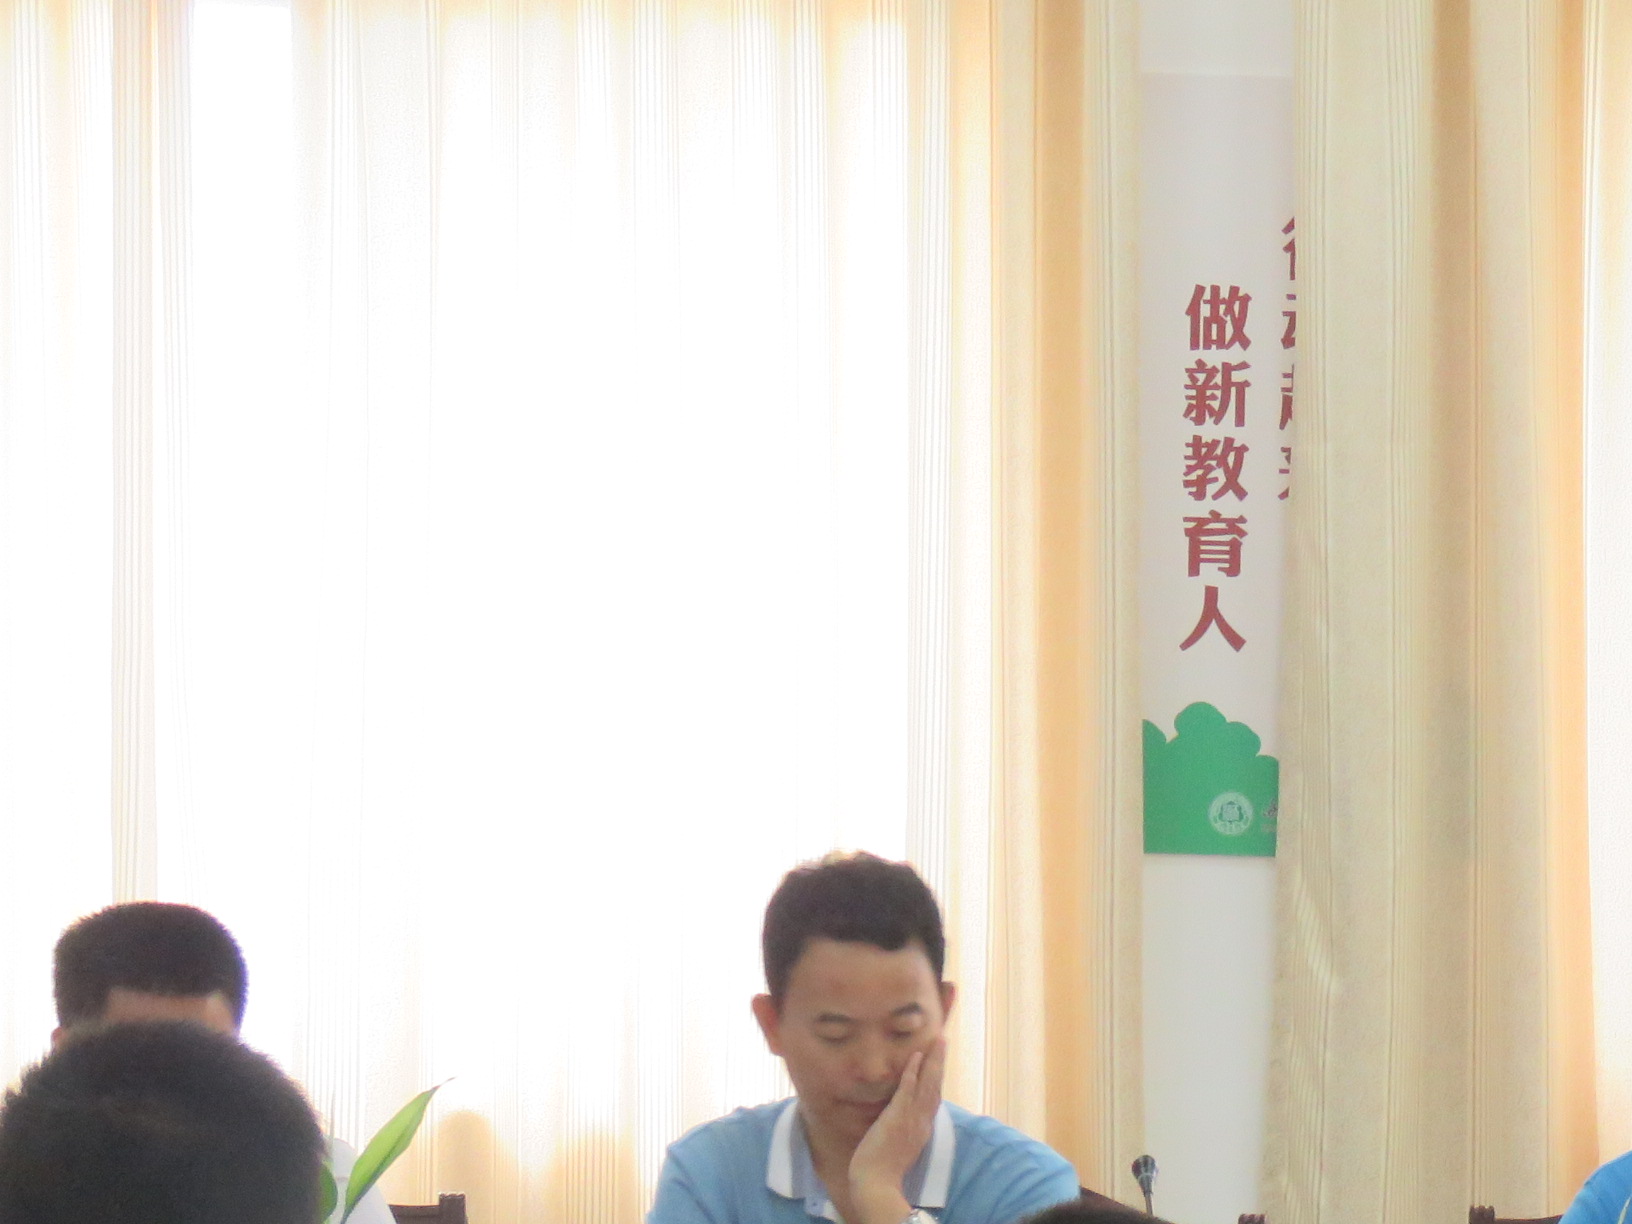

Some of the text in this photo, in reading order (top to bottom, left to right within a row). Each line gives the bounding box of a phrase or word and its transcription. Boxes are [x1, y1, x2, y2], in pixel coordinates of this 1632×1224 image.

[1179, 283, 1254, 653] 做新教育人
